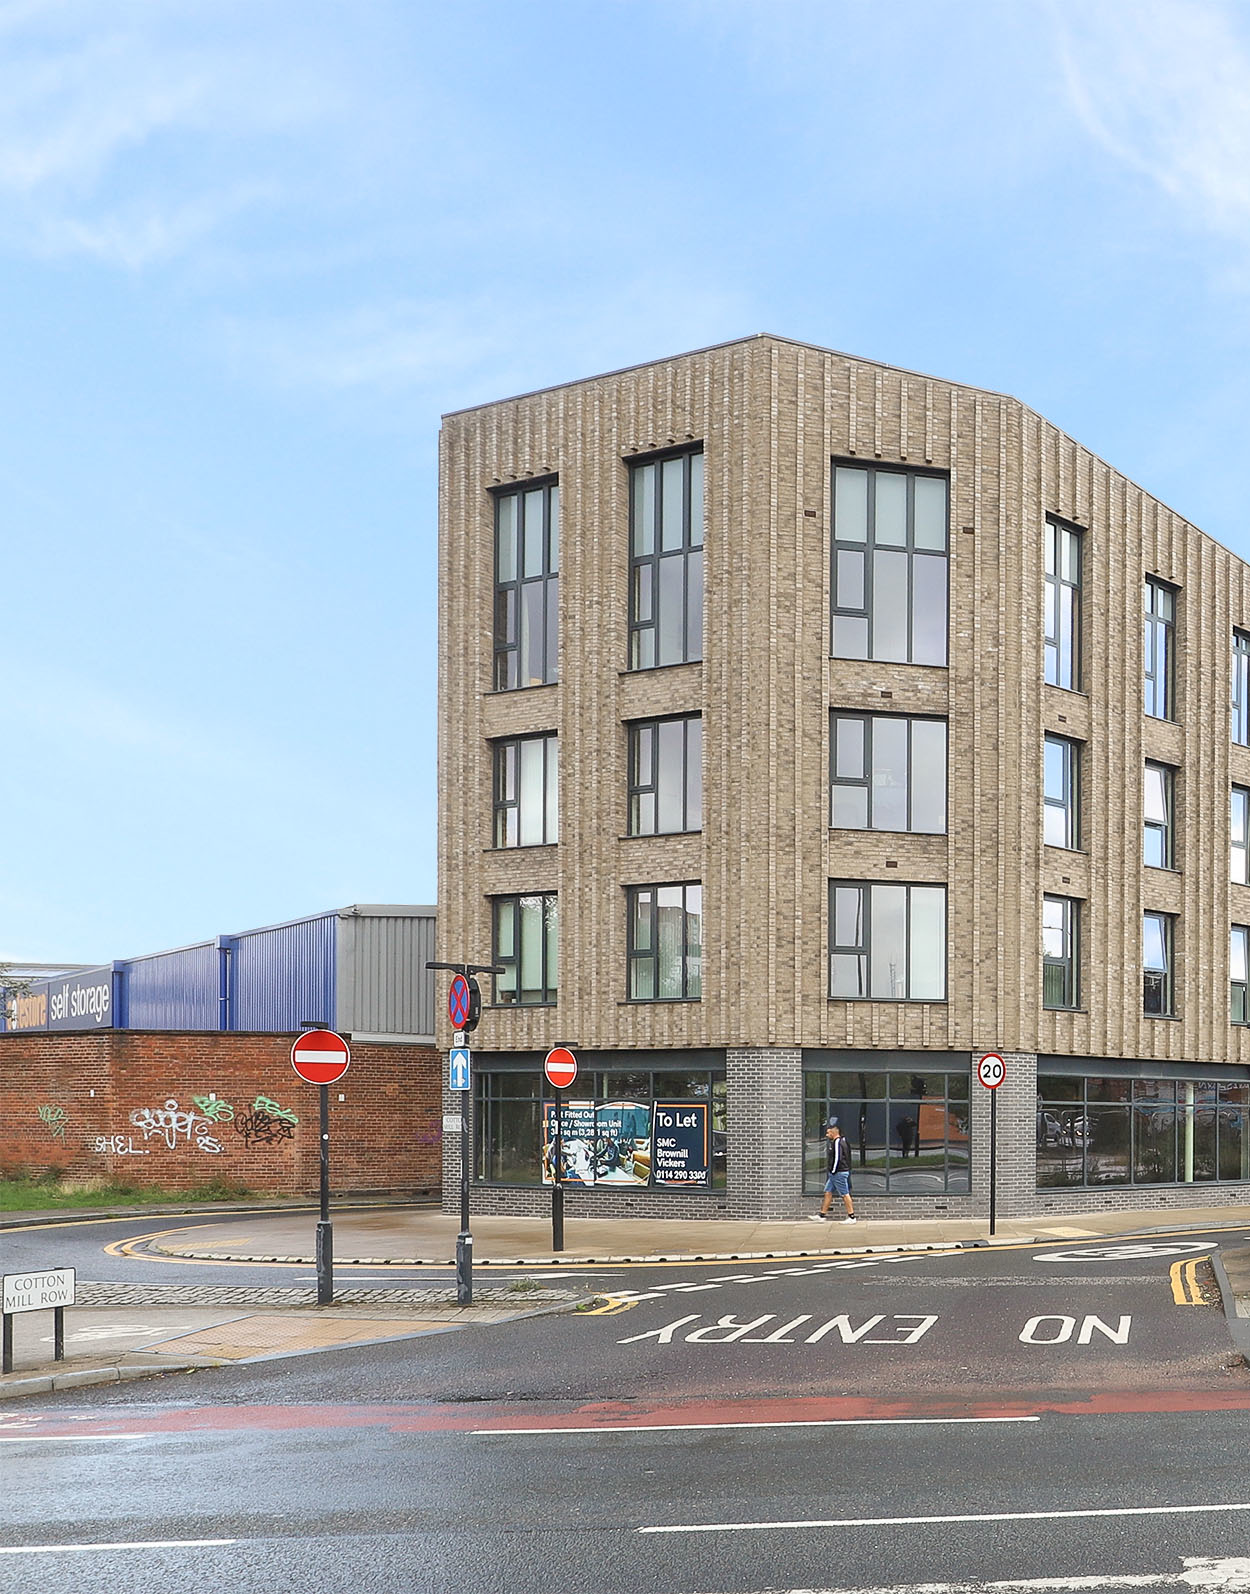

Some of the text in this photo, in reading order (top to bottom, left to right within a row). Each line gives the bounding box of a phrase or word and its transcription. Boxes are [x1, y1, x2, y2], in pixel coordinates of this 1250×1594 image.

[51, 984, 70, 1020] self
[71, 984, 109, 1023] storage
[983, 1064, 1002, 1078] 20
[608, 1120, 622, 1128] Unit
[656, 1112, 697, 1127] To Let
[564, 1129, 571, 1138] sq
[601, 1129, 609, 1138] sq
[610, 1128, 618, 1137] ft)
[656, 1138, 676, 1147] SMC
[656, 1148, 689, 1158] Brownill
[656, 1158, 686, 1168] Vickers
[656, 1170, 673, 1179] 0114
[674, 1170, 688, 1179] 290
[14, 1274, 65, 1291] COTTON
[5, 1289, 68, 1309] MILL ROW
[617, 1315, 1132, 1345] NO ENTRY
